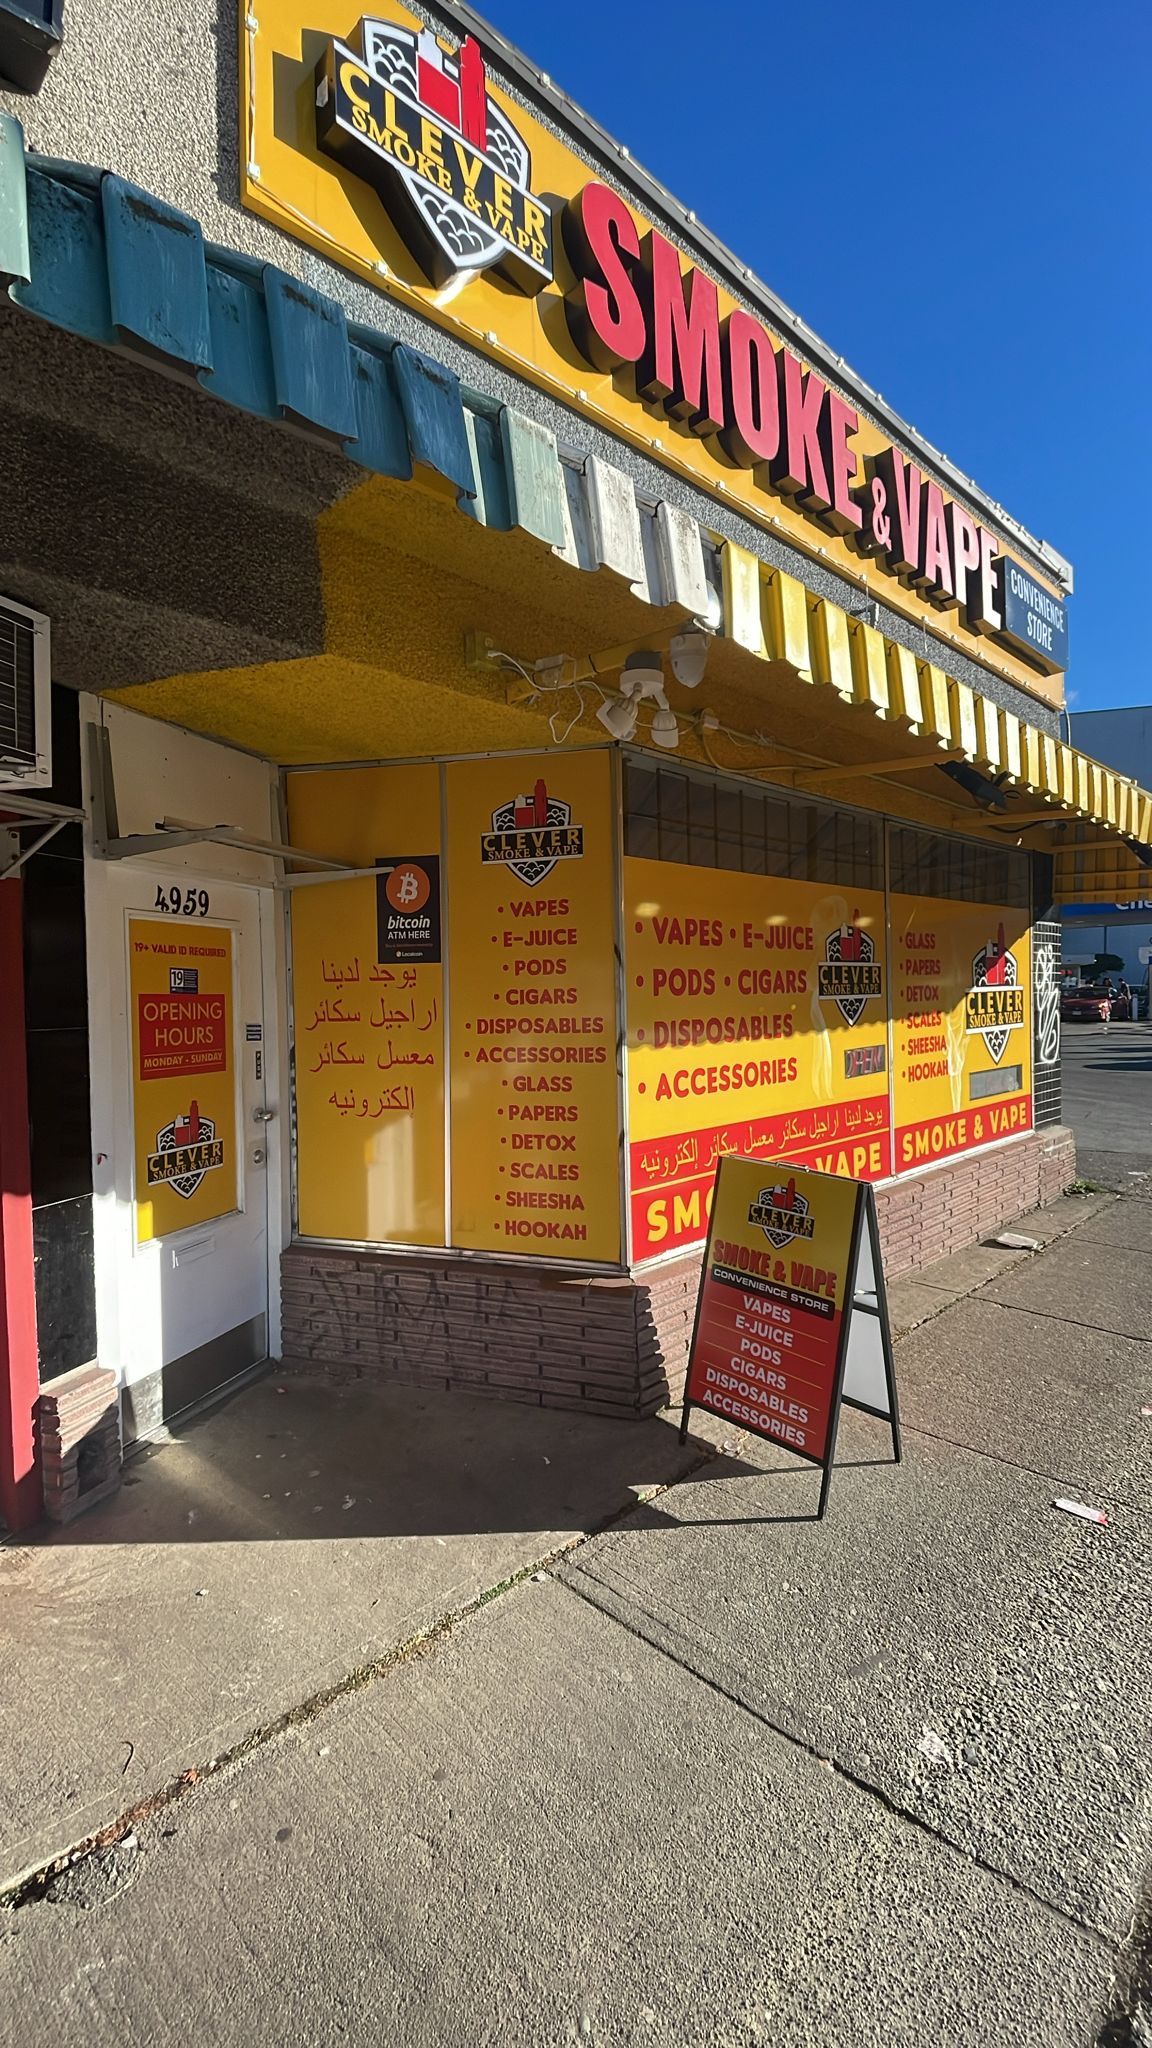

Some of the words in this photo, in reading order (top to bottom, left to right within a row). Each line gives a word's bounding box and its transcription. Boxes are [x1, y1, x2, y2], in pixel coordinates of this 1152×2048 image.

[339, 62, 550, 249] CLEVER
[351, 104, 453, 197] SMOKE
[463, 186, 482, 215] &
[485, 206, 545, 265] VAPE
[582, 181, 863, 530] SMOKE
[871, 477, 892, 547] &
[892, 447, 1002, 632] VAPE
[1010, 568, 1064, 633] CONVENIENCE
[1027, 611, 1053, 651] STORE
[483, 828, 582, 852] CLEVER
[488, 848, 532, 861] SMOKE
[535, 847, 545, 858] &
[545, 844, 579, 858] VAPE
[154, 885, 210, 917] 4959
[510, 899, 570, 918] VAPES
[387, 915, 430, 929] bitcoin
[652, 917, 722, 947] VAPES
[743, 921, 814, 950] E-JUICE
[387, 931, 406, 940] ATM
[408, 930, 430, 940] HERE
[502, 928, 578, 947] E-JUICE
[905, 931, 936, 950] GLASS
[134, 942, 149, 952] 19+
[151, 944, 176, 954] VALID
[179, 946, 187, 955] ID
[189, 947, 226, 958] REQUIRED
[171, 970, 183, 986] 19
[321, 957, 360, 990] لدينا
[368, 965, 417, 989] يوجد
[514, 958, 568, 977] PODS
[821, 965, 881, 986] CLEVER
[905, 957, 941, 977] PAPERS
[652, 968, 716, 997] PODS
[737, 968, 807, 995] CIGARS
[822, 984, 851, 996] SMOKE
[853, 984, 860, 995] &
[861, 983, 880, 995] VAPE
[906, 985, 939, 1001] DETOX
[505, 988, 578, 1006] CIGARS
[967, 991, 1023, 1015] CLEVER
[143, 1002, 223, 1022] OPENING
[305, 999, 361, 1031] سكائر
[370, 997, 438, 1031] اراجيل
[907, 1009, 942, 1029] SCALES
[969, 1012, 997, 1028] SMOKE
[998, 1012, 1004, 1024] &
[1004, 1010, 1022, 1024] VAPE
[154, 1026, 214, 1048] HOURS
[476, 1017, 605, 1035] DISPOSABLES
[653, 1014, 793, 1048] DISPOSABLES
[309, 1041, 365, 1072] سكائر
[377, 1040, 434, 1070] معسل
[475, 1046, 607, 1064] ACCESSORIES
[907, 1035, 947, 1056] SHEESHA
[144, 1054, 184, 1068] MONDAY
[190, 1051, 223, 1065] SUNDAY
[908, 1060, 949, 1082] HOOKAH
[512, 1075, 573, 1093] GLASS
[655, 1056, 798, 1101] ACCESSORIES
[508, 1104, 578, 1122] PAPERS
[844, 1105, 862, 1131] لدينا
[863, 1107, 883, 1125] يوجد
[511, 1133, 577, 1152] DETOX
[743, 1127, 774, 1154] معسل
[778, 1118, 806, 1149] سكائر
[902, 1118, 967, 1162] SMOKE
[973, 1115, 984, 1140] &
[989, 1102, 1027, 1132] VAPE
[149, 1142, 222, 1173] CLEVER
[705, 1132, 738, 1167] سكائر
[815, 1142, 881, 1178] VAPE
[152, 1164, 188, 1182] SMOKE
[189, 1161, 197, 1172] &
[198, 1155, 221, 1170] VAPE
[509, 1162, 580, 1181] SCALES
[505, 1192, 585, 1211] SHEESHA
[751, 1205, 813, 1231] CLEVER
[751, 1215, 780, 1230] SMOKE
[788, 1223, 812, 1237] VAPE
[504, 1220, 587, 1241] HOOKAH
[713, 1239, 770, 1275] SMOKE
[773, 1260, 786, 1282] &
[791, 1261, 837, 1298] VAPE
[714, 1269, 788, 1299] CONVENIENCE
[791, 1293, 829, 1312] STORE
[743, 1296, 791, 1324] VAPES
[735, 1315, 793, 1347] E-JUICE
[740, 1338, 782, 1365] PODS
[730, 1356, 787, 1390] CIGARS
[706, 1369, 808, 1424] DISPOSABLES
[703, 1389, 806, 1446] ACCESSORIES
